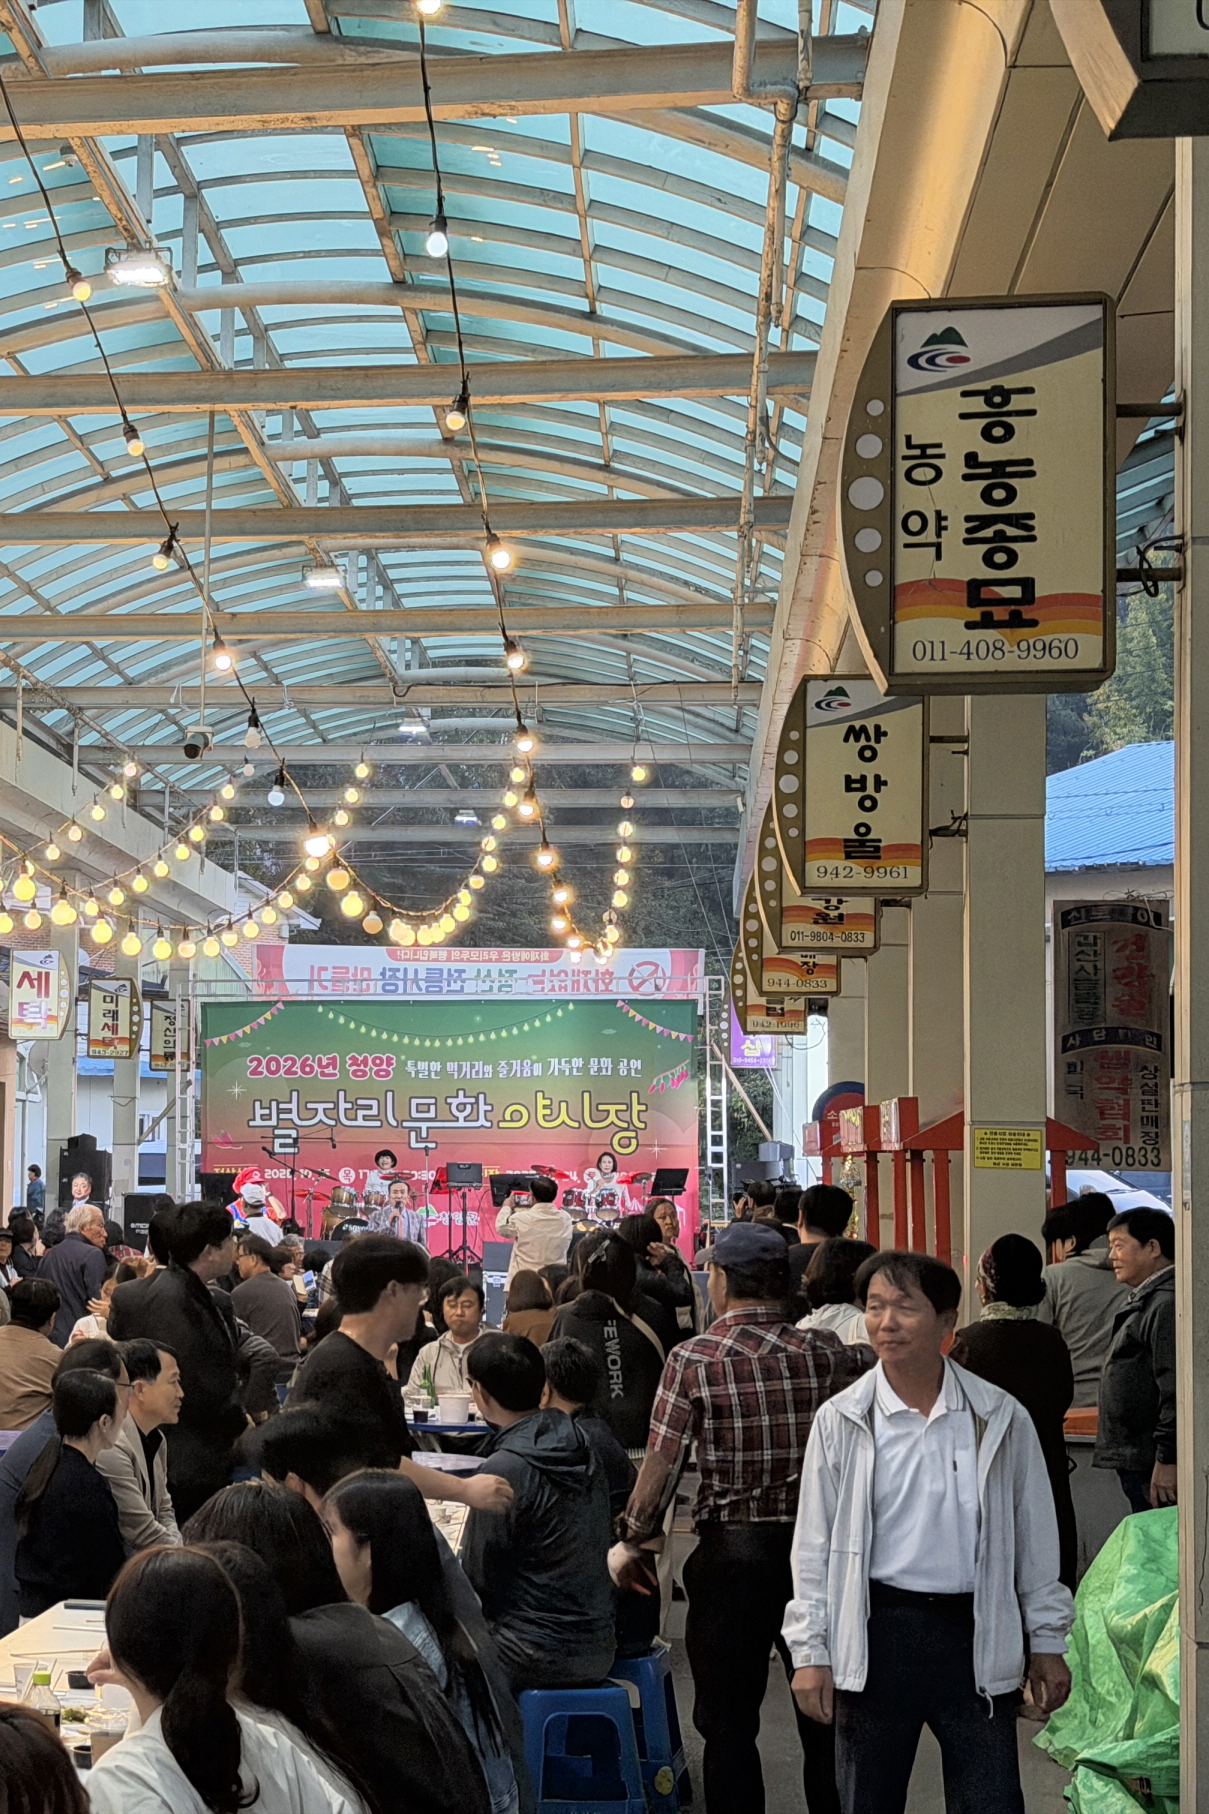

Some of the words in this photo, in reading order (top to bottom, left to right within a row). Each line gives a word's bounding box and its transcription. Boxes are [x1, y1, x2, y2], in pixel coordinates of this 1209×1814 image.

[901, 434, 948, 561] 농약
[958, 384, 1040, 630] 흥농종묘
[912, 637, 1080, 662] 011-408-9960
[843, 724, 889, 860] 쌍방울
[816, 865, 910, 880] 942-9961
[790, 930, 865, 943] 011-9804-0833
[767, 978, 828, 989] 944-0833
[247, 1053, 339, 1079] 2026년
[346, 1053, 396, 1080] 청양
[405, 1060, 442, 1079] 특별한
[446, 1061, 493, 1079] 먹거리와
[497, 1059, 542, 1078] 즐거움이
[547, 1057, 585, 1076] 가득한
[588, 1057, 613, 1076] 문화
[617, 1058, 642, 1077] 공연
